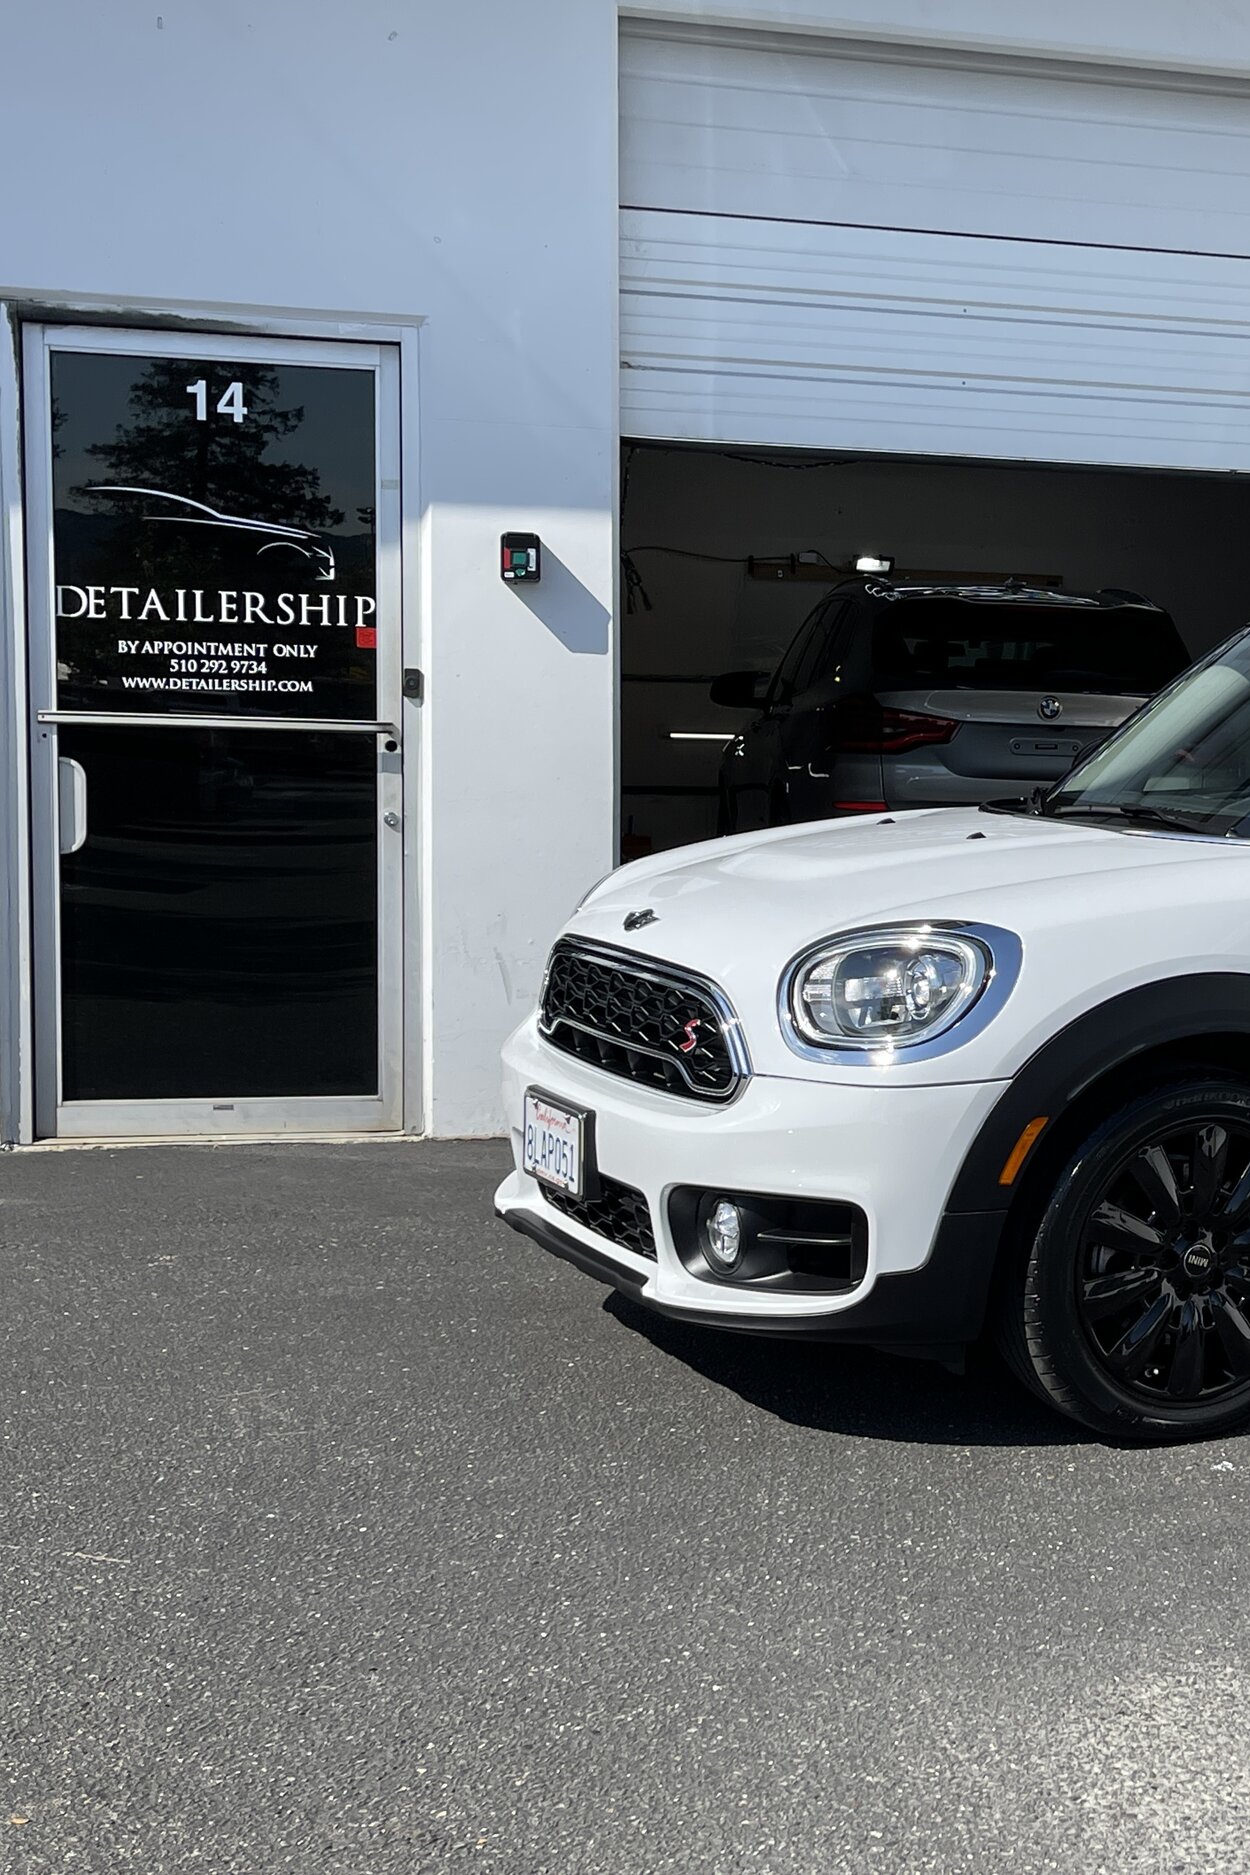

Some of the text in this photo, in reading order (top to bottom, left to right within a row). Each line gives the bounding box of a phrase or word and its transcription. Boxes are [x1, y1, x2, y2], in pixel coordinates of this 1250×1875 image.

[186, 379, 248, 423] 14
[56, 585, 376, 627] DETAILERSHIP
[118, 640, 318, 658] BY APPOINTMENT ONLY
[169, 659, 267, 674] 510 292 9734
[121, 676, 314, 692] WWW.DETAILERSHIP.COM
[527, 1123, 576, 1183] 8LAP051
[1187, 1254, 1209, 1268] MINI
